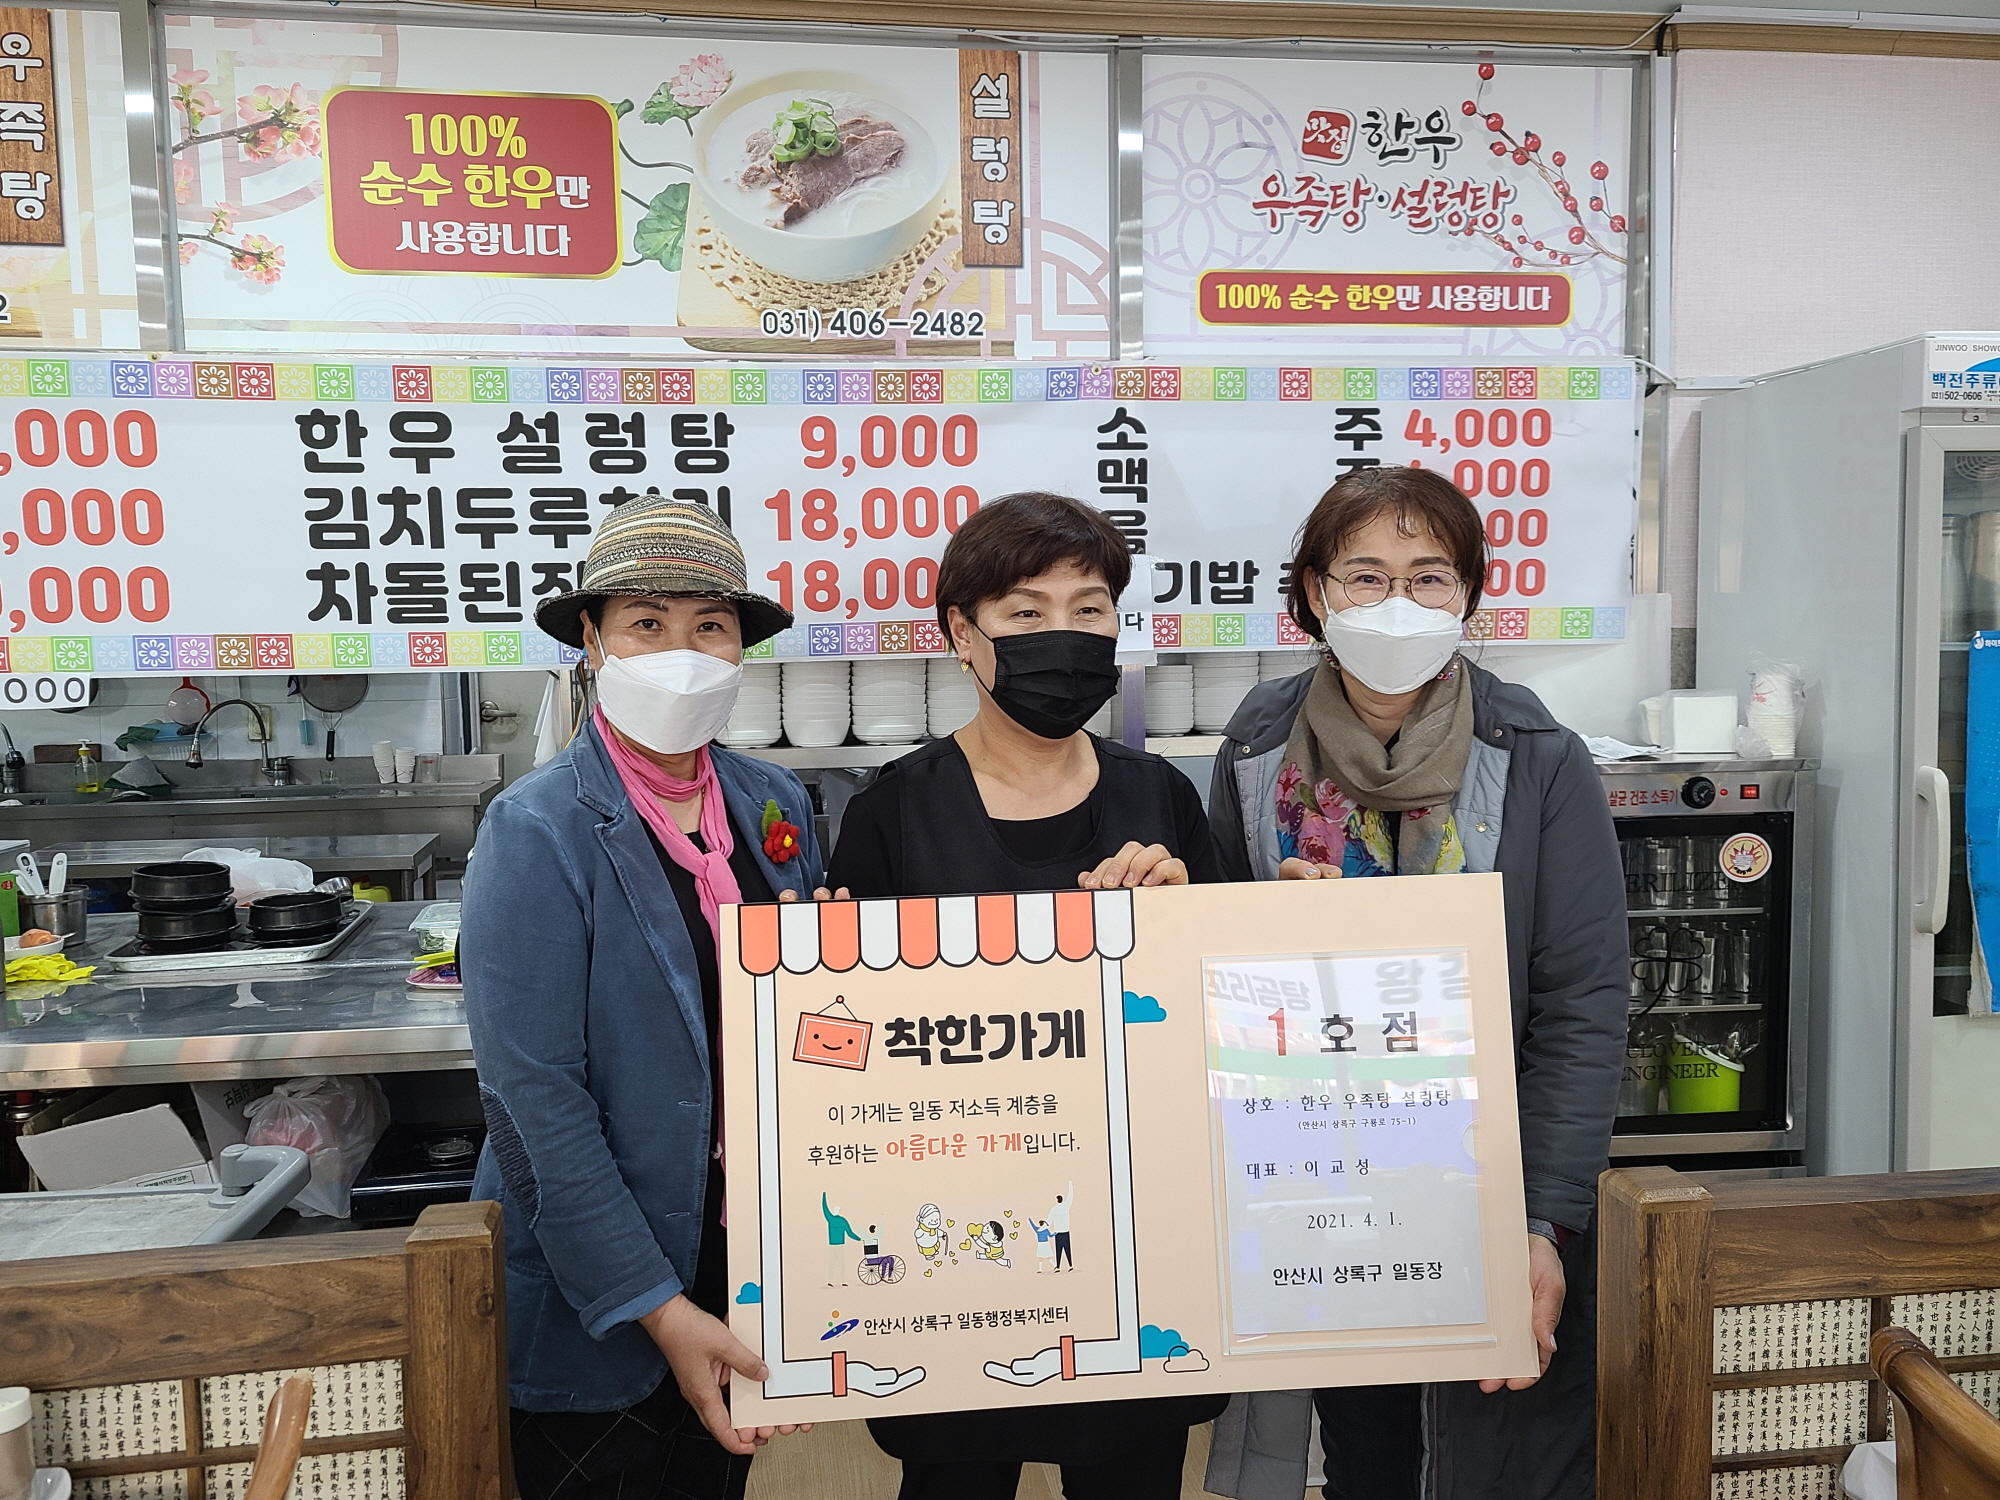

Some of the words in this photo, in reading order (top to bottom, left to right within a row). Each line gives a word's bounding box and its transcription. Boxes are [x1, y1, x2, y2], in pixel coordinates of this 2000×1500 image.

[0, 33, 52, 221] 우족탕
[404, 113, 527, 159] 100%
[1361, 109, 1456, 164] 한우
[970, 73, 1016, 245] 설렁탕
[359, 161, 453, 207] 순수
[463, 164, 591, 210] 한우만
[395, 221, 571, 257] 사용합니다
[1215, 284, 1282, 310] 100%
[1288, 284, 1340, 311] 순수
[1345, 285, 1422, 311] 한우만
[1427, 285, 1552, 311] 사용합니다
[1934, 344, 1968, 352] JINWOO
[800, 414, 979, 478] 9,000
[1404, 408, 1552, 454] 4,000
[764, 485, 980, 549] 18,000
[0, 566, 170, 633] ,000
[766, 557, 940, 619] 18,00
[1153, 560, 1260, 605] 기밥
[1609, 790, 1627, 807] 살균
[1630, 789, 1648, 806] 건조
[1651, 788, 1678, 805] 소독기
[885, 1009, 1086, 1066] 착한가게
[1268, 1007, 1287, 1057] 1
[1320, 1013, 1357, 1053] 호
[1382, 1011, 1418, 1052] 점
[1625, 1041, 1709, 1059] CLOVER
[828, 1104, 844, 1125] 이
[850, 1102, 904, 1124] 가게는
[908, 1100, 944, 1122] 일동
[949, 1097, 1001, 1119] 저소득
[1006, 1094, 1058, 1116] 계층을
[1242, 1096, 1275, 1115] 상호
[1300, 1094, 1333, 1112] 한우
[1342, 1092, 1392, 1110] 우족탕
[1401, 1089, 1451, 1108] 설렁탕
[1298, 1120, 1327, 1131] (안산시
[1360, 1117, 1387, 1128] 구룡로
[1390, 1116, 1416, 1127] 75-1)
[807, 1144, 879, 1166] 후원하는
[886, 1133, 967, 1162] 아름다운
[976, 1131, 1081, 1154] 가게입니다.
[1246, 1162, 1279, 1180] 대표
[1307, 1213, 1353, 1230] 2021.
[1363, 1212, 1378, 1227] 4.
[1389, 1211, 1402, 1226] 1.
[1273, 1266, 1323, 1286] 안산시
[1333, 1264, 1382, 1284] 상록구
[1392, 1261, 1442, 1281] 일동장
[864, 1316, 906, 1336] 안산시
[910, 1314, 953, 1333] 상록구
[957, 1305, 1069, 1330] 일동행정복지센터
